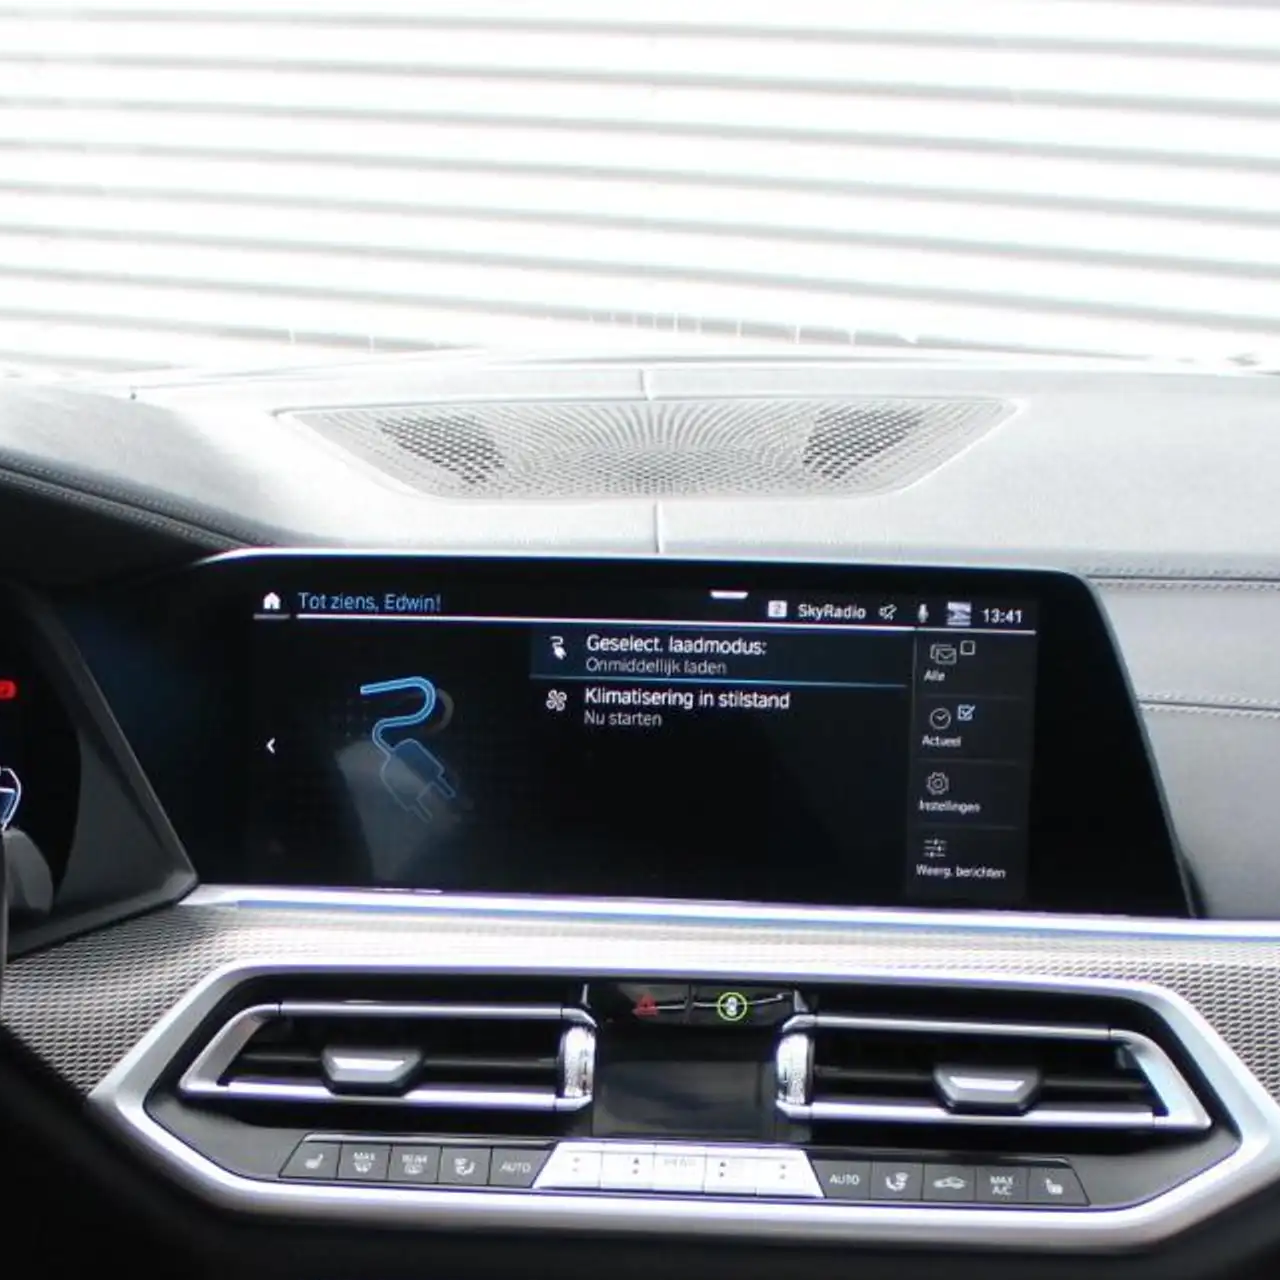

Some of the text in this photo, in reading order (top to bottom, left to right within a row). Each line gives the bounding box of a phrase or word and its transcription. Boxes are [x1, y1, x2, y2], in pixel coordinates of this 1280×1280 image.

[297, 592, 442, 613] Tot ziens, Edwin!
[797, 603, 867, 621] SkyRadio
[981, 608, 1023, 623] 13:41
[586, 634, 767, 655] Geselect. laadmodus:
[586, 657, 728, 676] Onmiddellijk laden
[584, 687, 791, 710] Klimatisering in stilstand
[584, 710, 663, 727] Nu starten
[500, 1162, 531, 1174] AUTO
[829, 1174, 861, 1186] AUTO
[989, 1176, 1014, 1186] MAX
